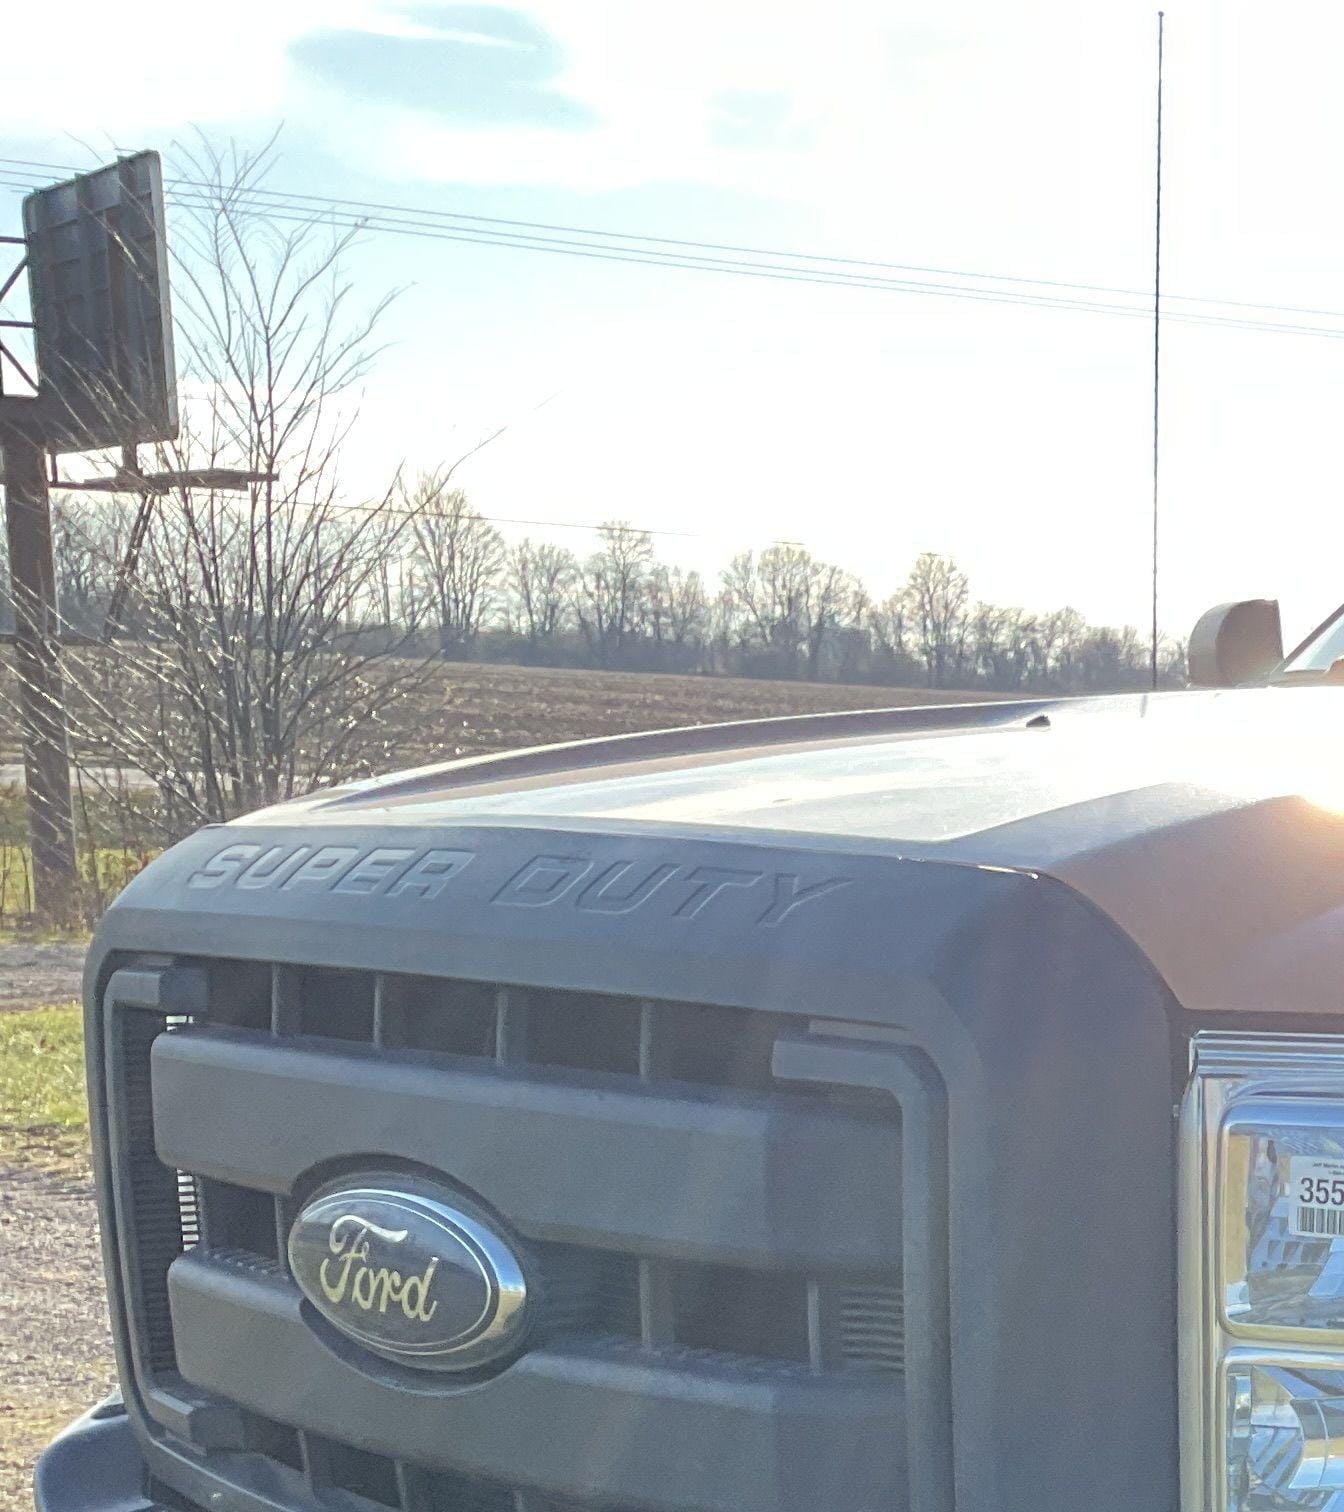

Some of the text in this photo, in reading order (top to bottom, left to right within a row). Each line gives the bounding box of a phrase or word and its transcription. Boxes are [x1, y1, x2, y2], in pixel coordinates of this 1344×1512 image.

[187, 843, 853, 928] SUPER DUTY
[319, 1214, 438, 1322] Ford
